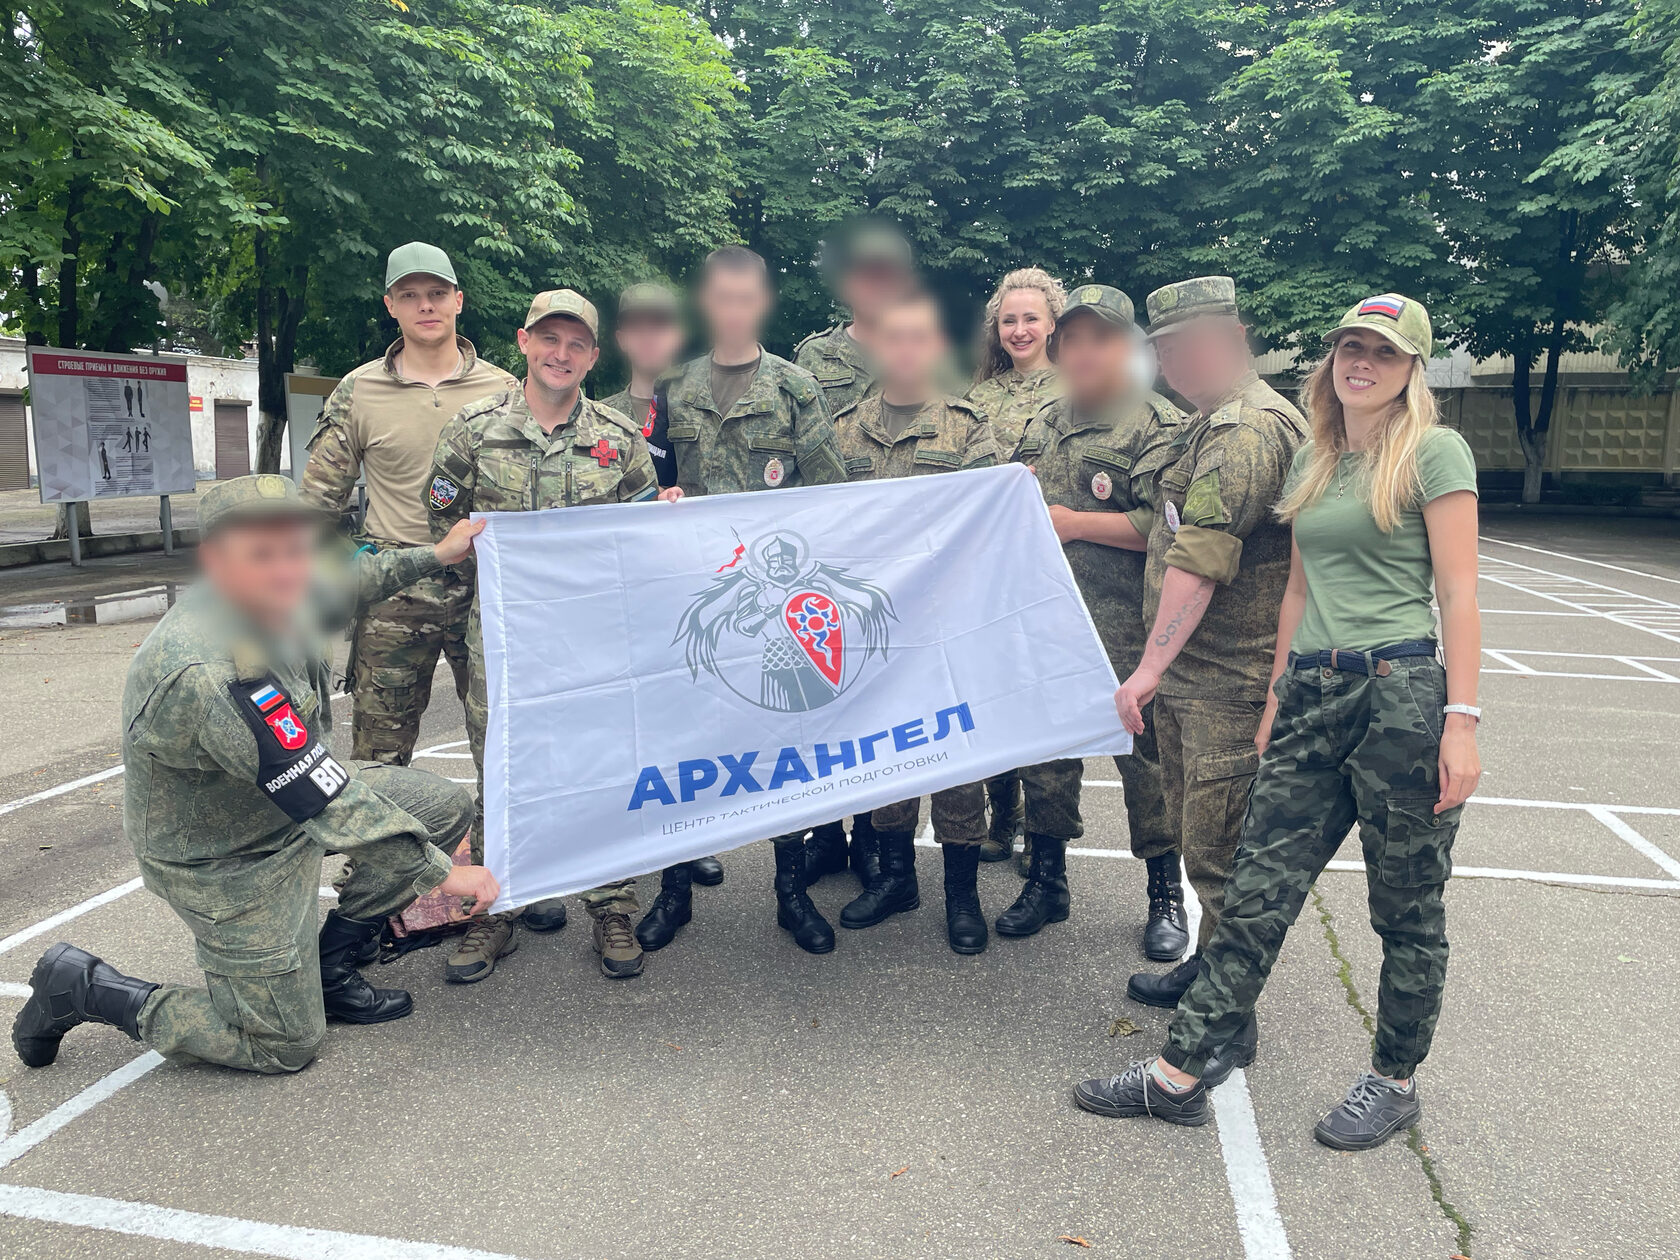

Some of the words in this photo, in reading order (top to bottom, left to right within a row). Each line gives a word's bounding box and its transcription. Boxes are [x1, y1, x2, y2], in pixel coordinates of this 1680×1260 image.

[57, 360, 84, 371] СТРОЕВЫЕ
[85, 362, 107, 372] ПРИЕМЫ
[107, 363, 112, 372] И
[112, 364, 139, 374] ДВИЖЕНИЯ
[139, 366, 148, 375] БЕЗ
[148, 367, 167, 376] ОРУЖИЯ
[265, 754, 314, 794] ВОЕННАЯ
[309, 756, 348, 797] ВП
[627, 701, 975, 811] АРХАНГЕЛ
[662, 816, 716, 836] ЦЕНТР
[720, 782, 835, 820] ТАКТИЧЕСКОЙ
[839, 751, 949, 788] ПОДГОТОВКИ
